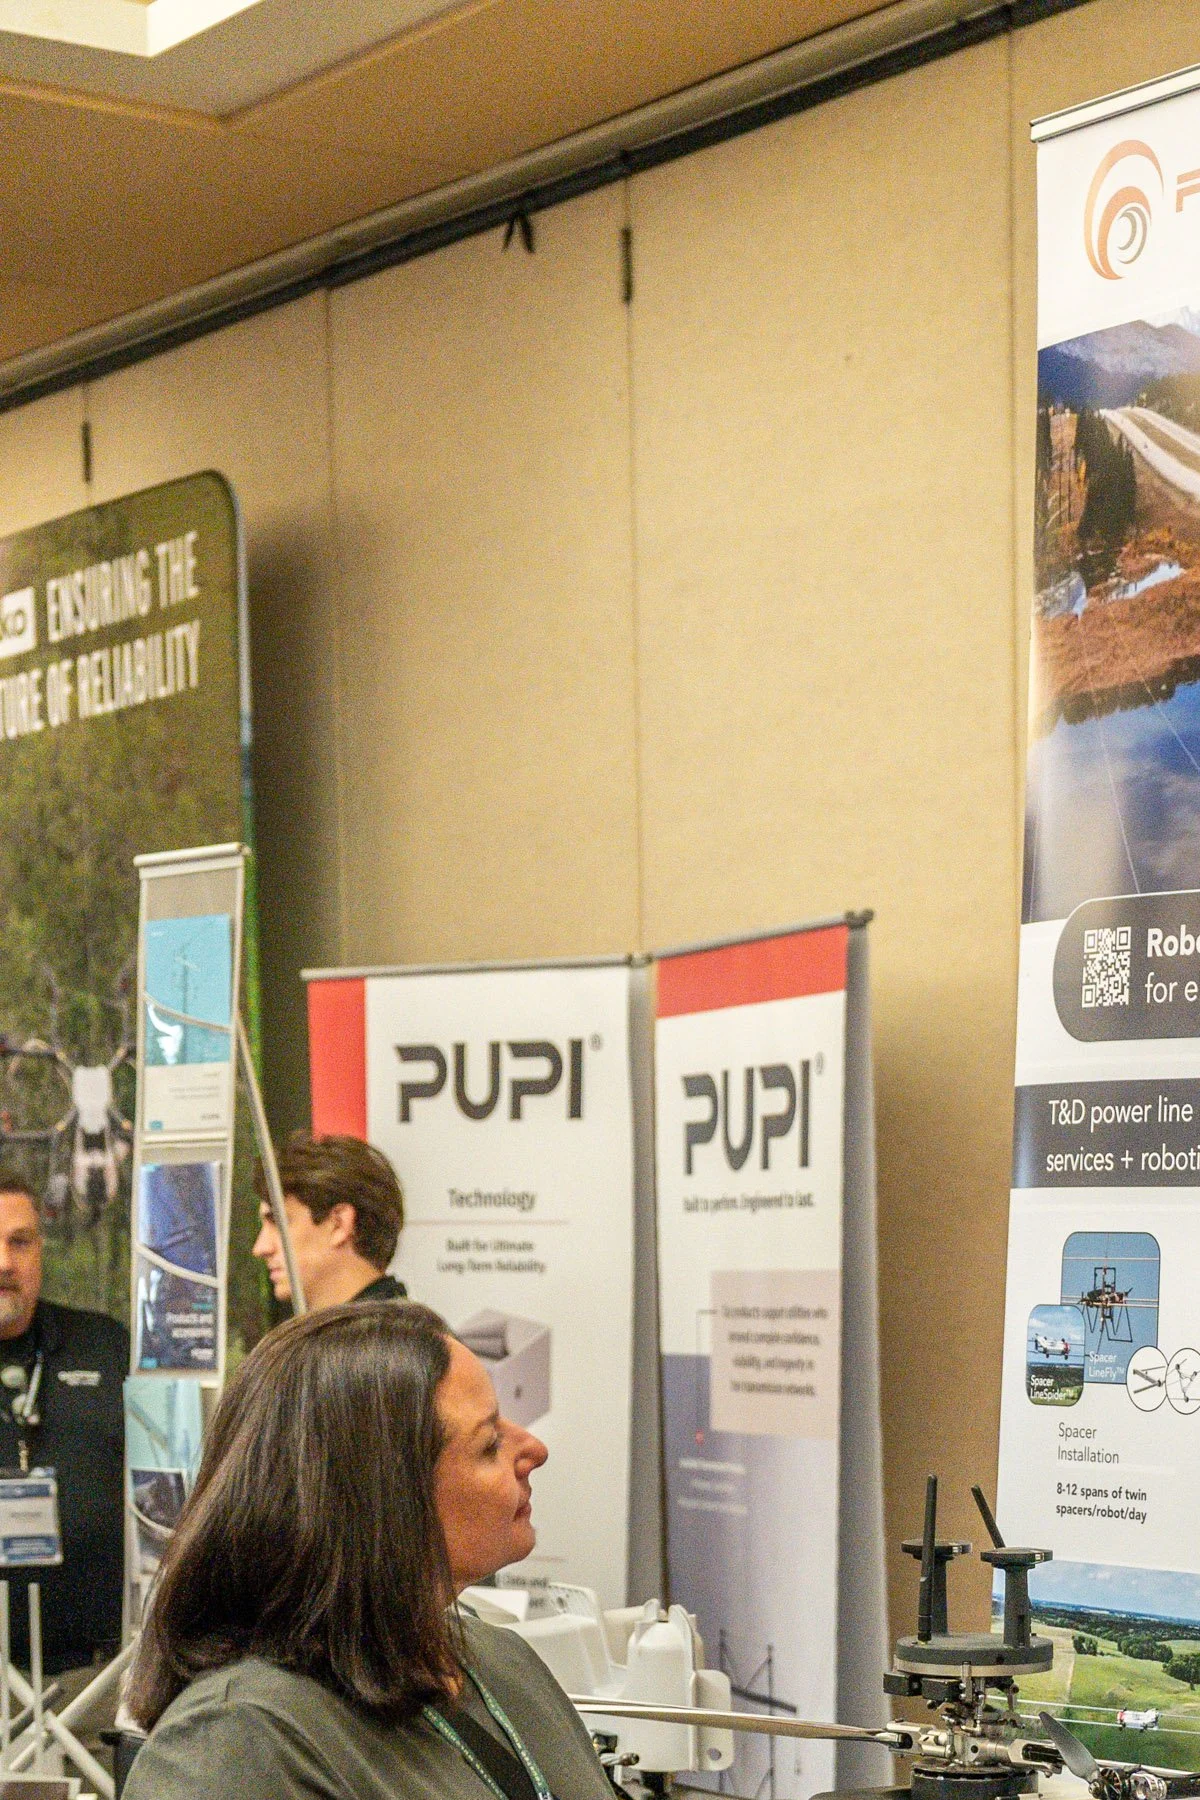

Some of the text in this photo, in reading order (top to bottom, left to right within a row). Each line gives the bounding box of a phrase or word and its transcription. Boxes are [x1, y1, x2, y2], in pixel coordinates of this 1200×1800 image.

[47, 550, 151, 643] ENSURING
[155, 530, 199, 609] THE
[47, 659, 73, 727] OF
[77, 620, 200, 718] RELIABILITY
[1144, 971, 1177, 1003] for
[1048, 1099, 1086, 1126] T&D
[1090, 1103, 1152, 1133] power
[1157, 1094, 1194, 1124] line
[1045, 1146, 1115, 1173] services
[1120, 1152, 1135, 1170] +
[448, 1188, 537, 1214] Technology
[1088, 1353, 1118, 1367] Spacer
[1030, 1374, 1055, 1388] Spacer
[1058, 1421, 1097, 1440] Spacer
[1057, 1445, 1120, 1464] Installation
[1056, 1481, 1148, 1502] 8-12 spans of twin
[1055, 1502, 1148, 1525] spacers/robot/day
